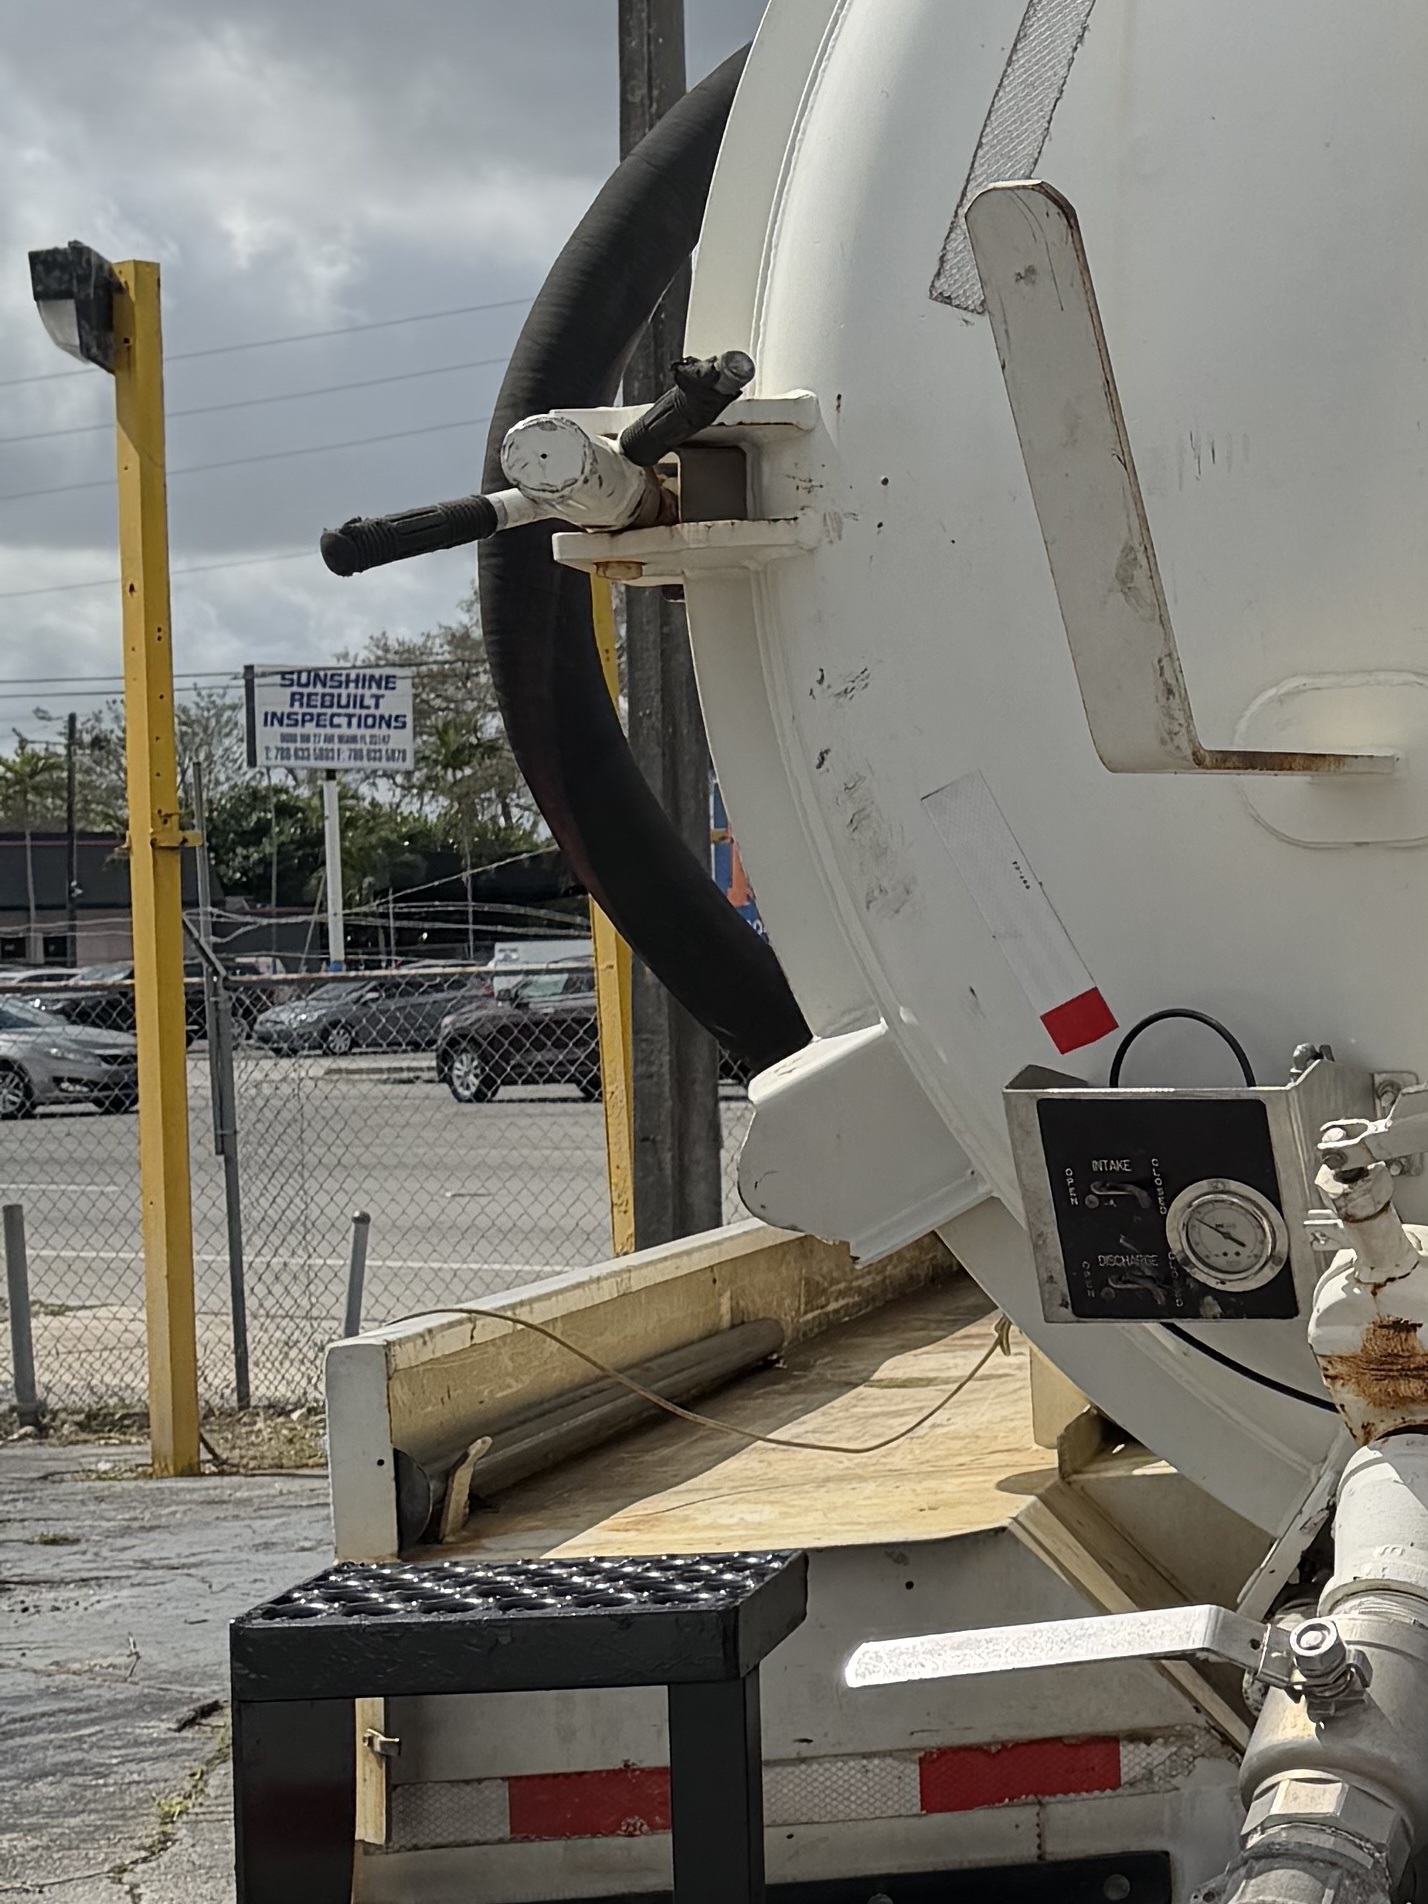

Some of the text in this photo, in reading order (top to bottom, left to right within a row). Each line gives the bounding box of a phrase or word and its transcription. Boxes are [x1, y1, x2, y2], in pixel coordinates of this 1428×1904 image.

[279, 670, 398, 690] SUNSHINE
[289, 691, 385, 710] REBUILT
[263, 711, 407, 730] INSPECTIONS
[1092, 1159, 1132, 1172] INTAKE
[1097, 1254, 1159, 1267] DISCHARGE
